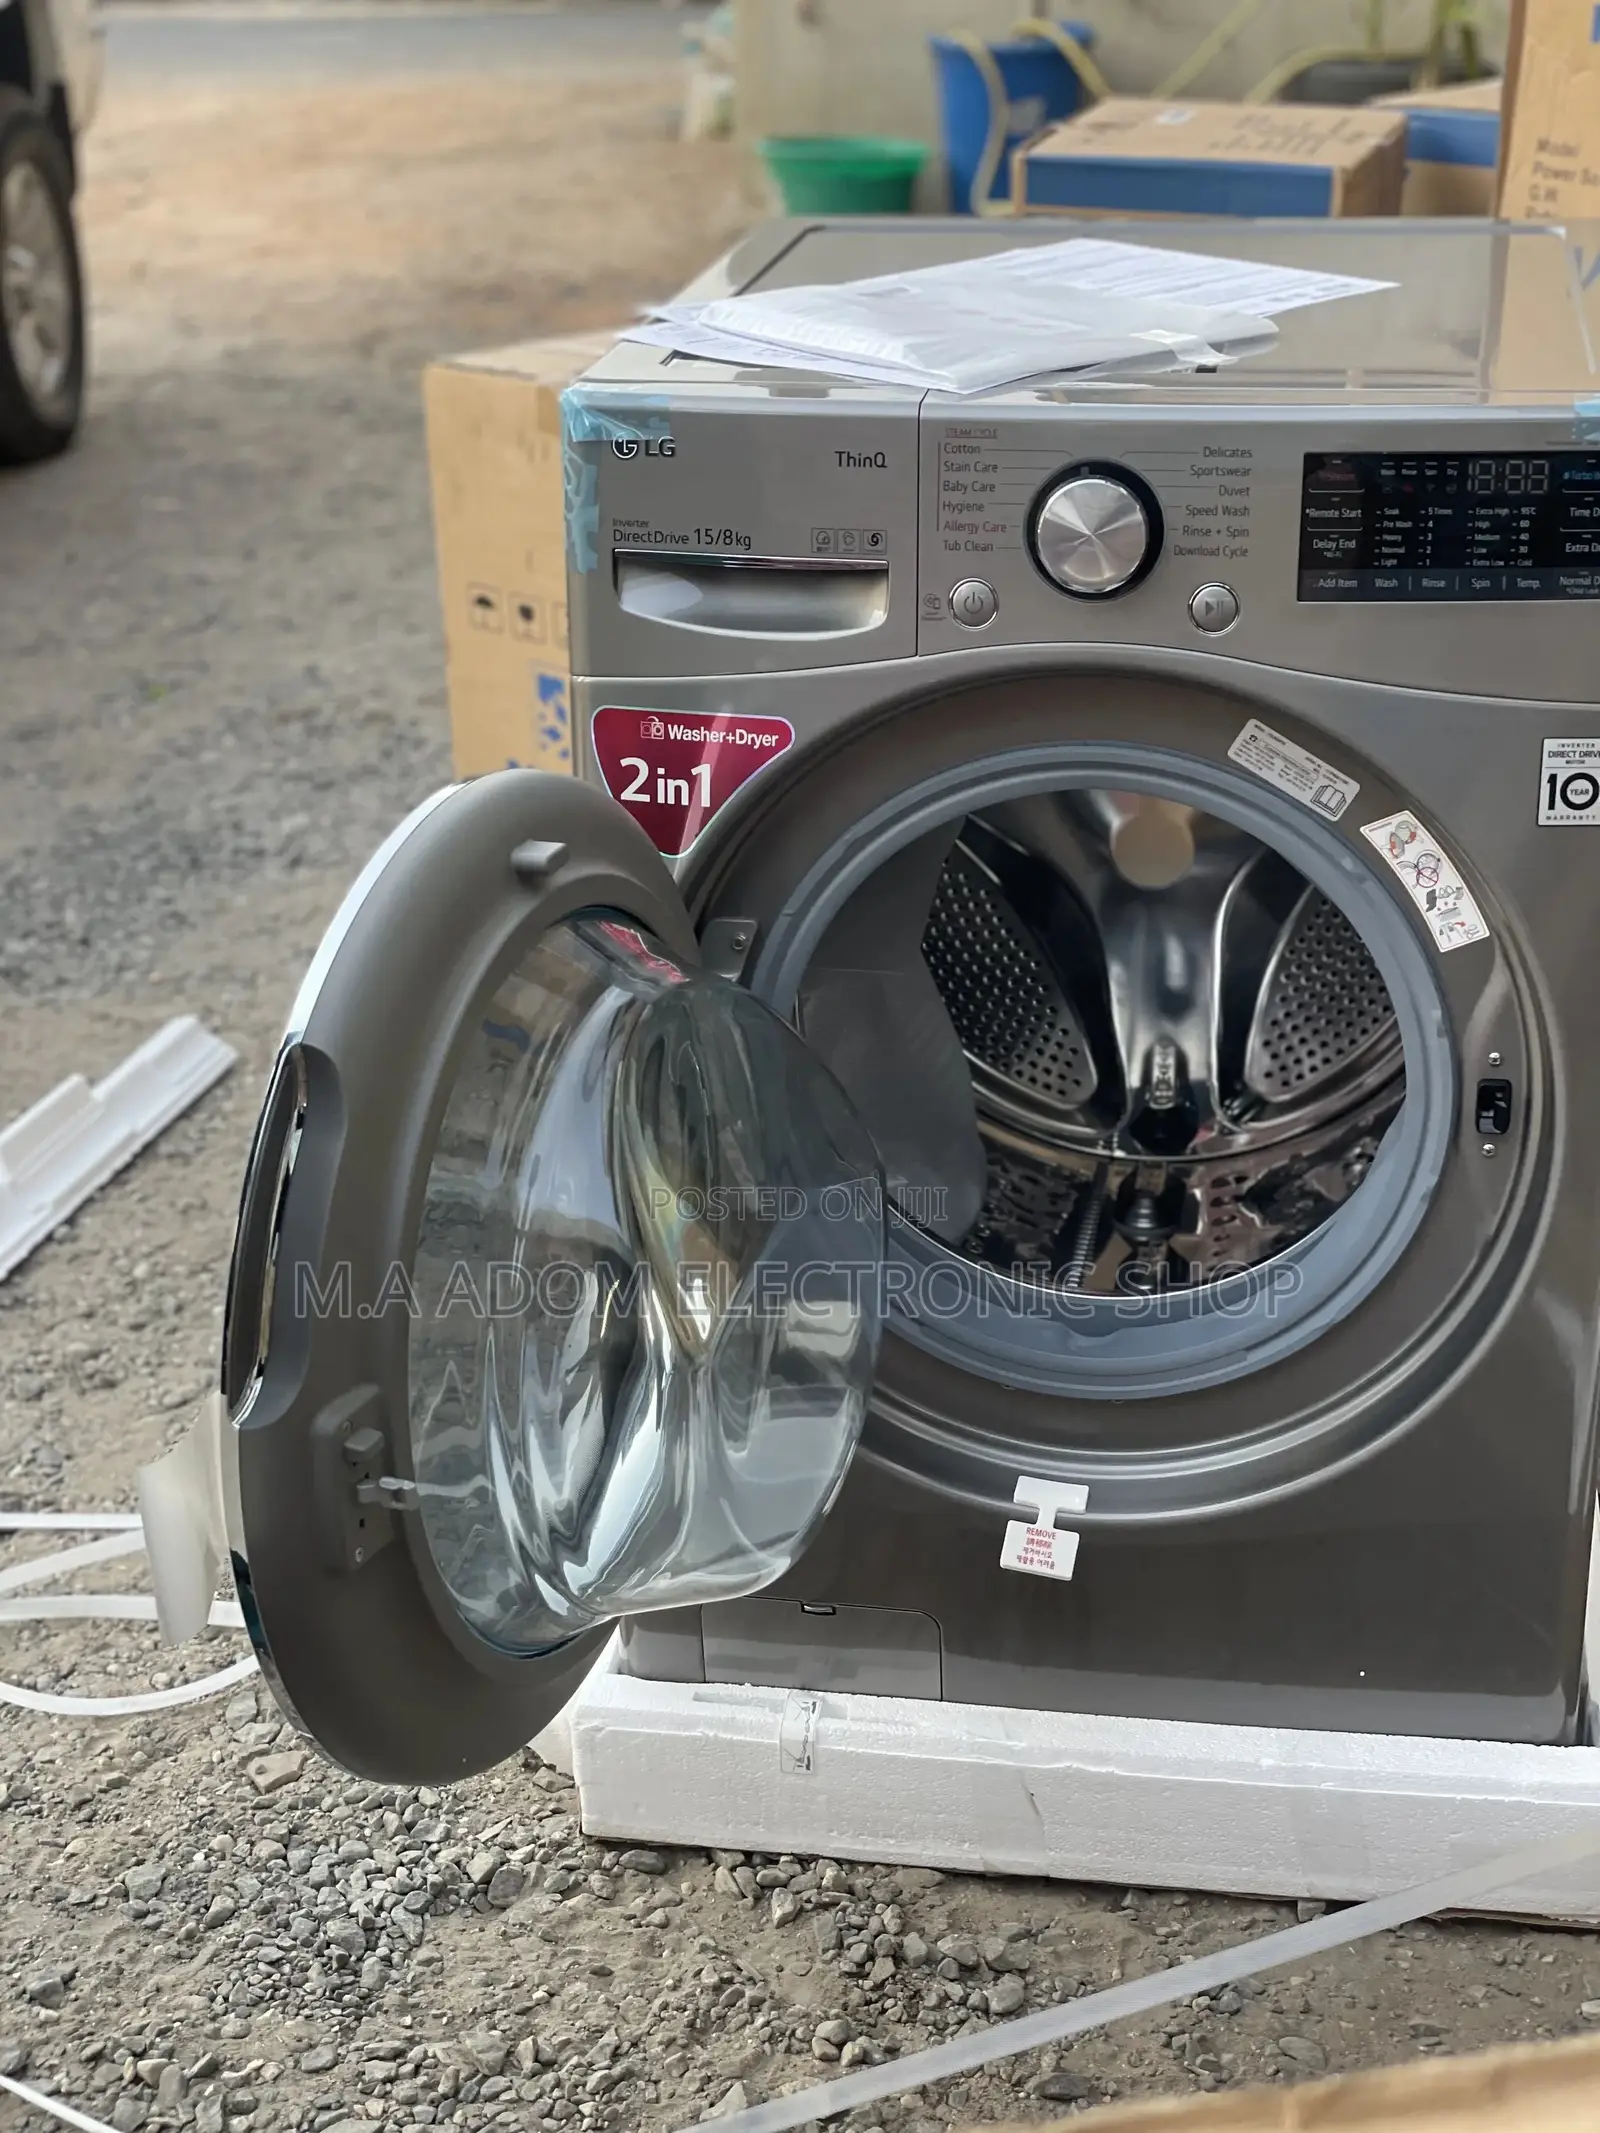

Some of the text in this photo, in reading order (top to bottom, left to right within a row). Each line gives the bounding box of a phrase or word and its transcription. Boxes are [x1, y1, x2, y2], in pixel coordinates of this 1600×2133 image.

[645, 436, 676, 456] LG
[943, 442, 981, 454] Cotton
[1203, 446, 1253, 458] Delicates
[835, 451, 887, 468] ThinQ
[943, 460, 998, 473] Stain Care
[1190, 464, 1252, 479] Sportswear
[943, 480, 996, 495] Baby Care
[1219, 484, 1250, 497] Duvet
[942, 500, 985, 515] Hygiene
[1185, 504, 1250, 518] Speed Wash
[1341, 508, 1362, 518] Start
[1428, 506, 1433, 515] 5
[1570, 507, 1591, 517] Time
[612, 518, 649, 528] Inverter
[943, 520, 1007, 535] Allergy Care
[1427, 520, 1434, 528] 4
[1182, 525, 1212, 537] Rinse
[1226, 526, 1250, 539] Spin
[1427, 533, 1433, 541] 3
[943, 540, 994, 552] Tub Clean
[1313, 539, 1356, 551] Delay End
[1426, 545, 1432, 554] 2
[1565, 542, 1590, 553] Extra
[1173, 544, 1249, 560] Download Cycle
[1318, 578, 1358, 588] Add Item
[1374, 578, 1399, 588] Wash
[1422, 578, 1446, 588] Rinse
[1471, 577, 1491, 589] Spin
[1559, 576, 1591, 586] Normal
[668, 724, 779, 749] Washer+Dryer
[1548, 750, 1577, 758] DIRECT
[1547, 772, 1600, 811] 10
[1569, 788, 1590, 796] YEAR
[1026, 1527, 1057, 1540] REMOVE
